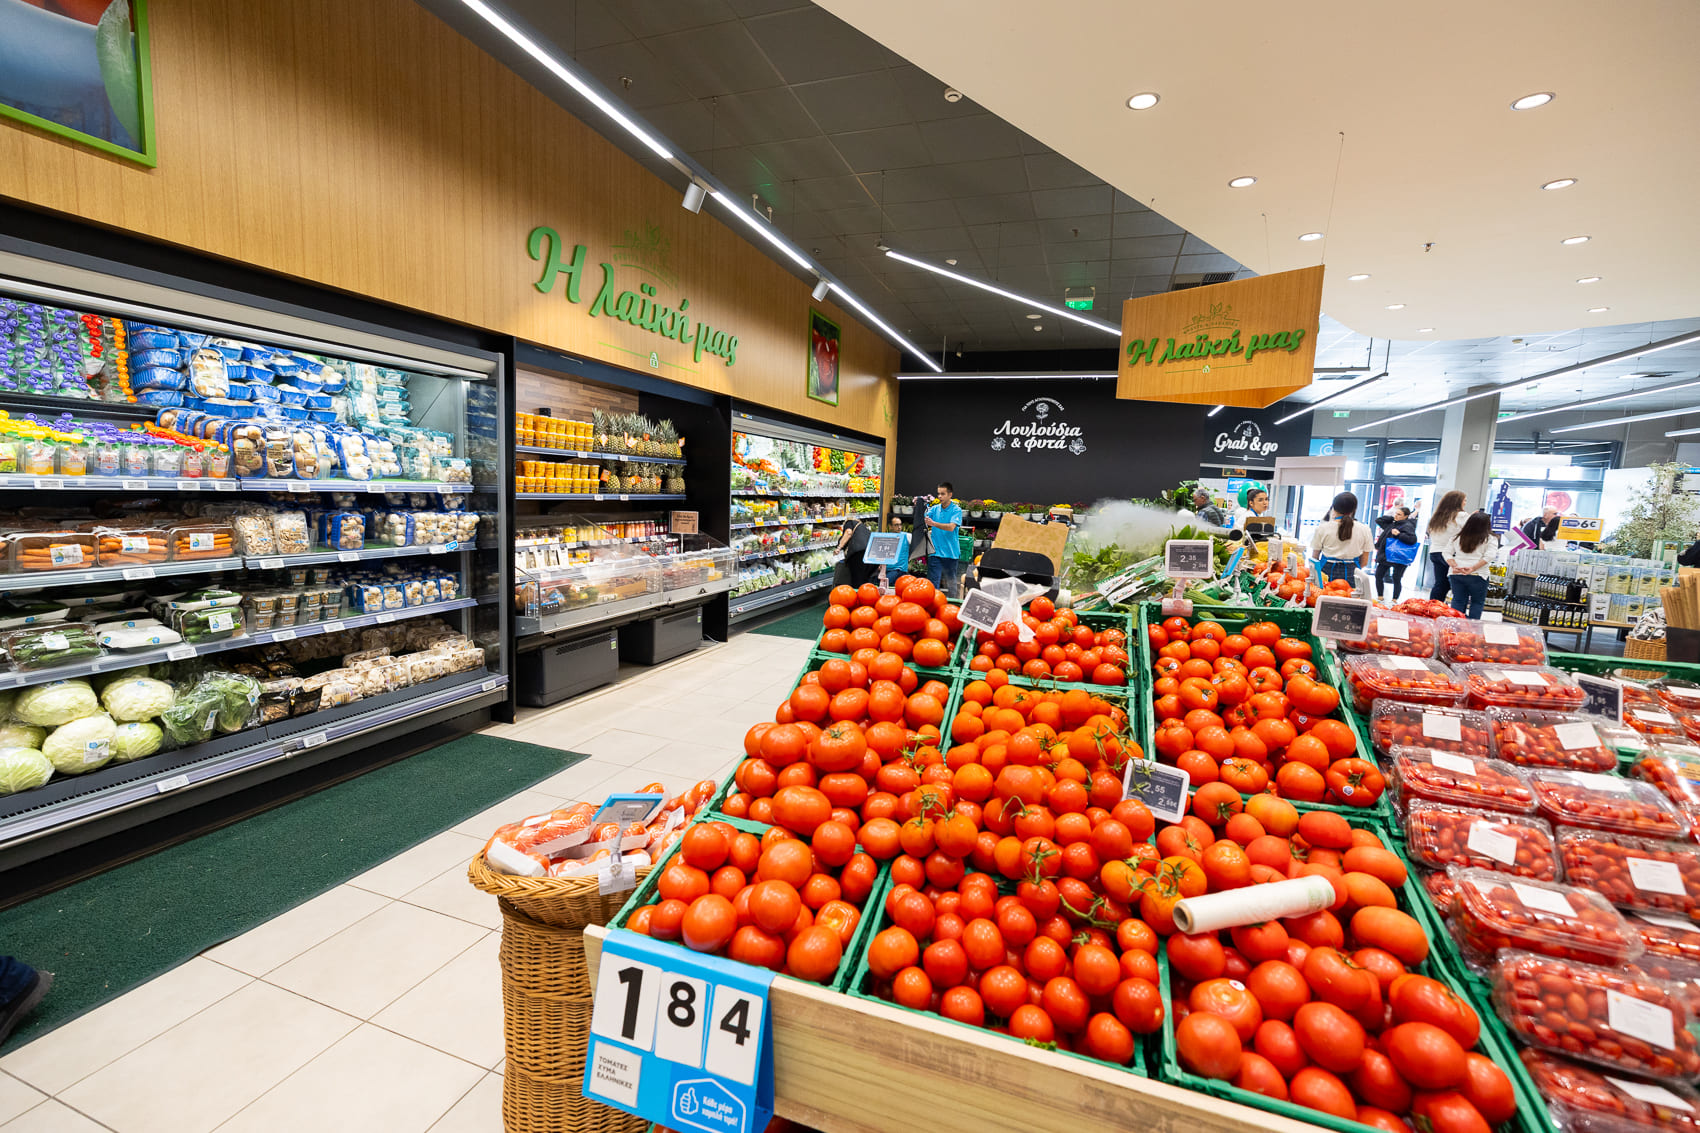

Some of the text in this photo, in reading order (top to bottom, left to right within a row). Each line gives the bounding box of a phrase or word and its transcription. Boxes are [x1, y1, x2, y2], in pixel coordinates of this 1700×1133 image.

[527, 226, 587, 303] Η
[589, 263, 694, 344] λαϊκή
[693, 322, 739, 366] μας
[1127, 329, 1306, 365] Η λαϊκή μας
[994, 420, 1082, 437] Λουλούδια
[1011, 435, 1067, 453] & φυτά
[1214, 433, 1278, 456] Grab & go
[598, 1063, 616, 1075] ΧΥΜΑ
[599, 1056, 628, 1071] ΤΟΜΑΤΕΣ
[596, 1071, 633, 1090] ΕΛΛΗΝΙΚΕΣ
